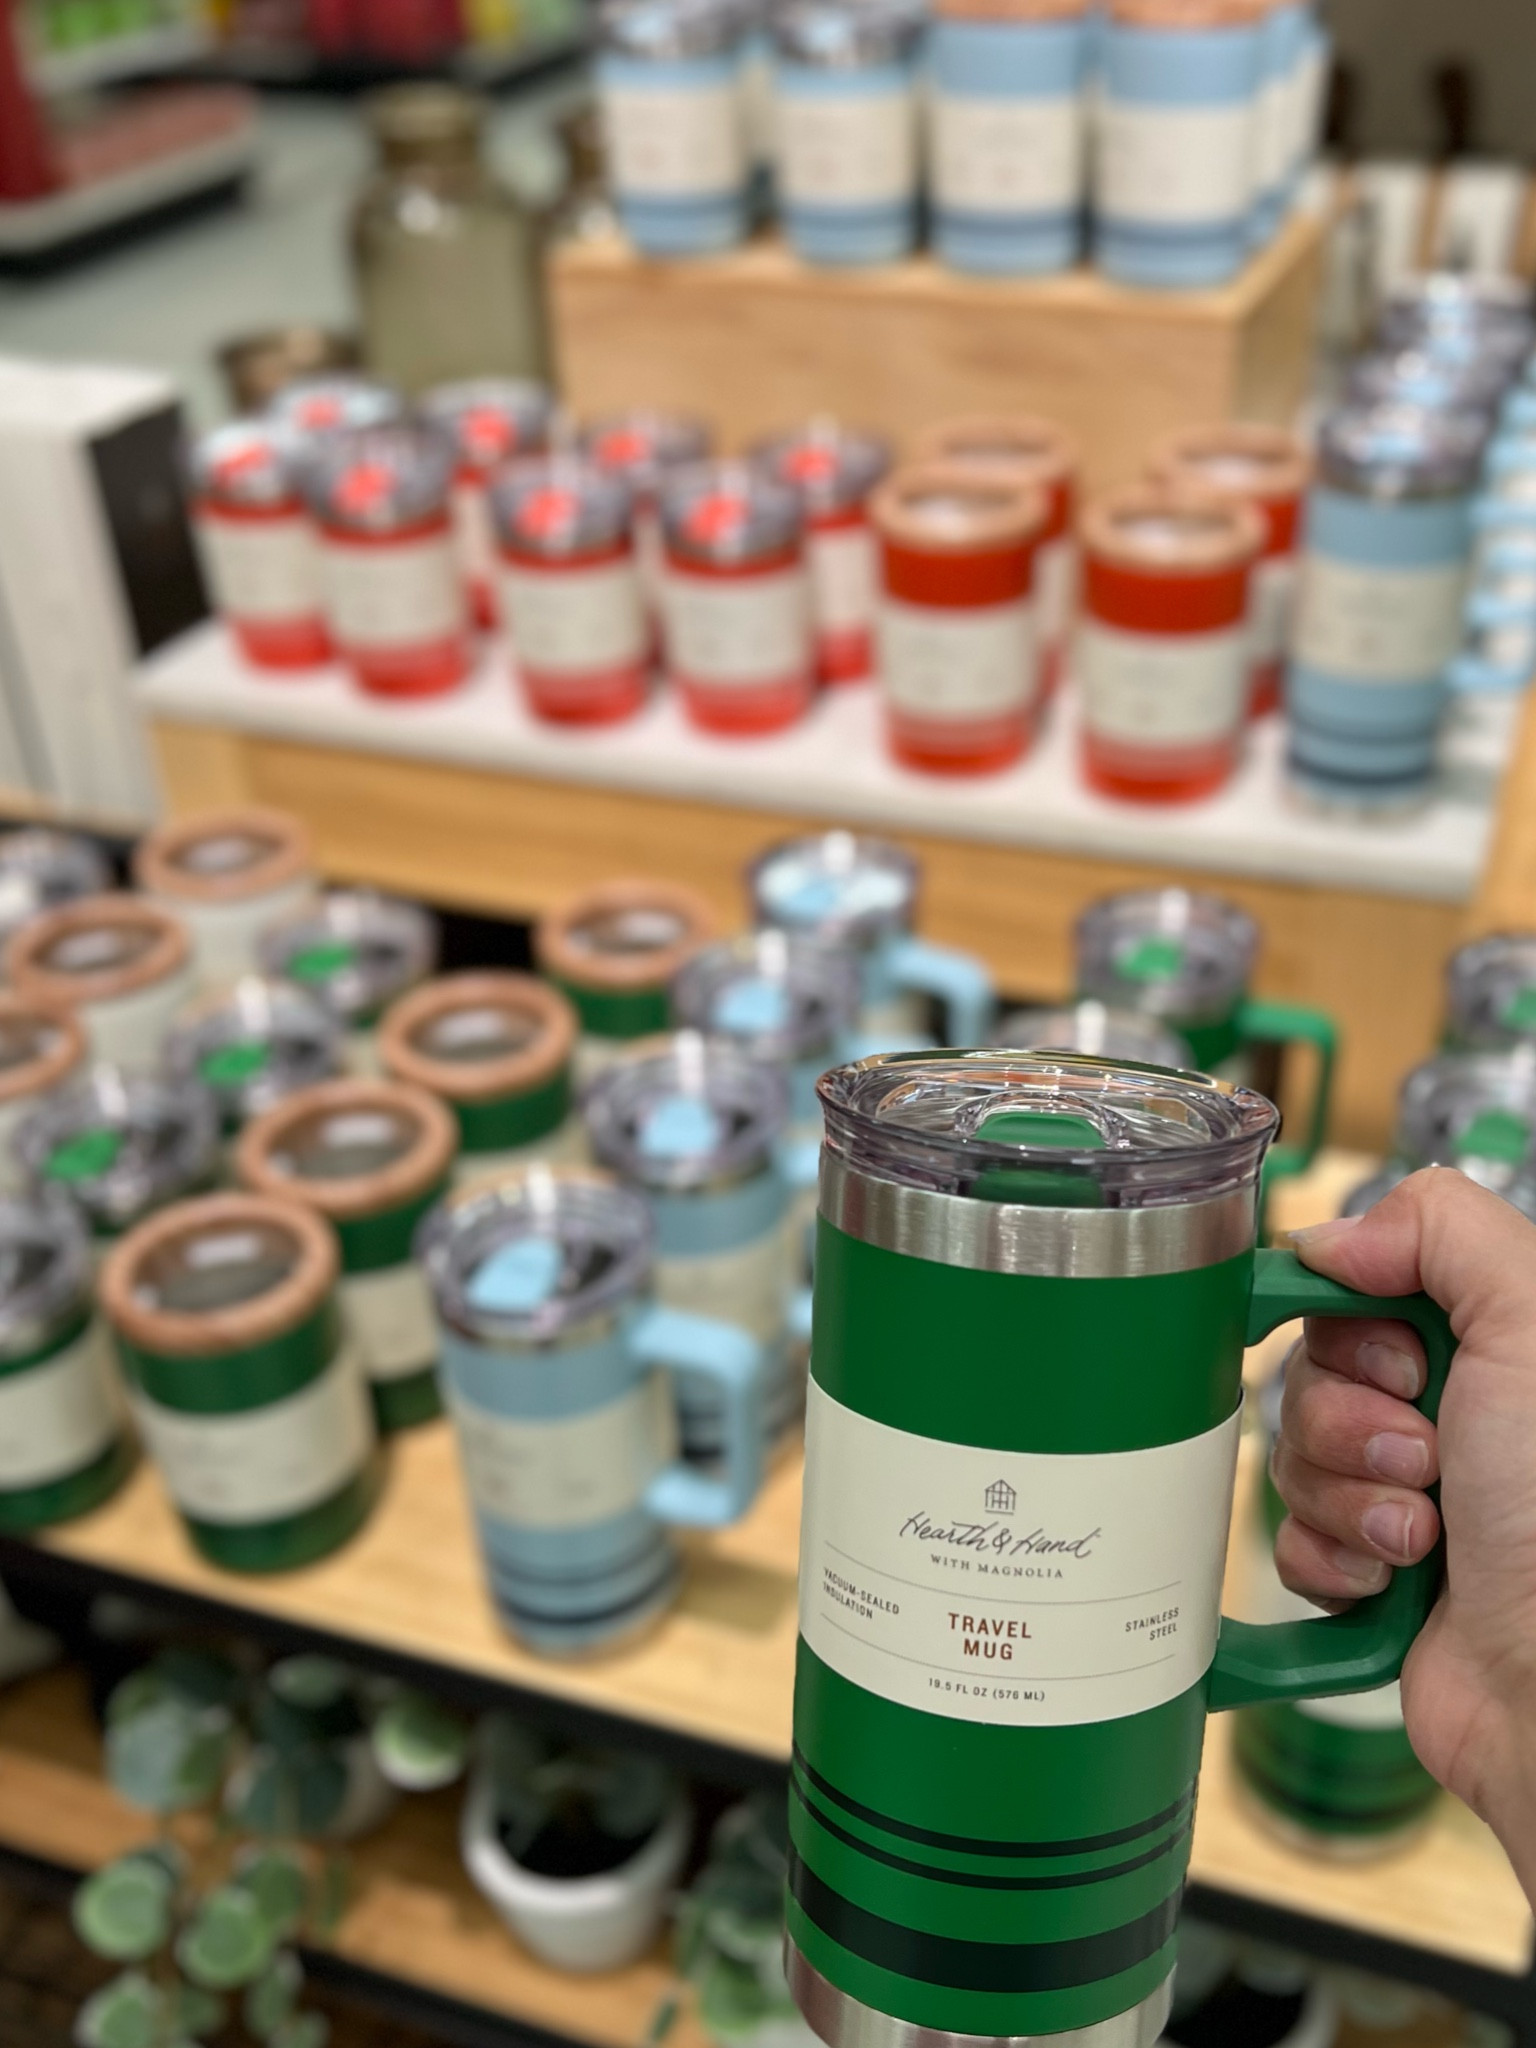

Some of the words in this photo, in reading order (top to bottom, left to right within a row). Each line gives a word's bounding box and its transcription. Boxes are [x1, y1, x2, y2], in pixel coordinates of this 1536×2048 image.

[899, 1511, 999, 1551] Hearth
[992, 1528, 1014, 1555] &
[1009, 1527, 1101, 1559] Hand
[931, 1554, 970, 1570] WITH
[978, 1563, 1063, 1579] MAGNOLIA
[823, 1567, 900, 1615] VACUUM-SEALED
[823, 1581, 873, 1619] INSULATION
[948, 1612, 1032, 1639] TRAVEL
[1125, 1607, 1179, 1632] STAINLESS
[1149, 1622, 1177, 1641] STEEL
[963, 1638, 1013, 1660] MUG
[928, 1678, 952, 1691] 19.5
[956, 1684, 968, 1694] FL
[973, 1686, 988, 1697] OZ
[993, 1689, 1019, 1700] (576
[1024, 1691, 1046, 1702] ML)
